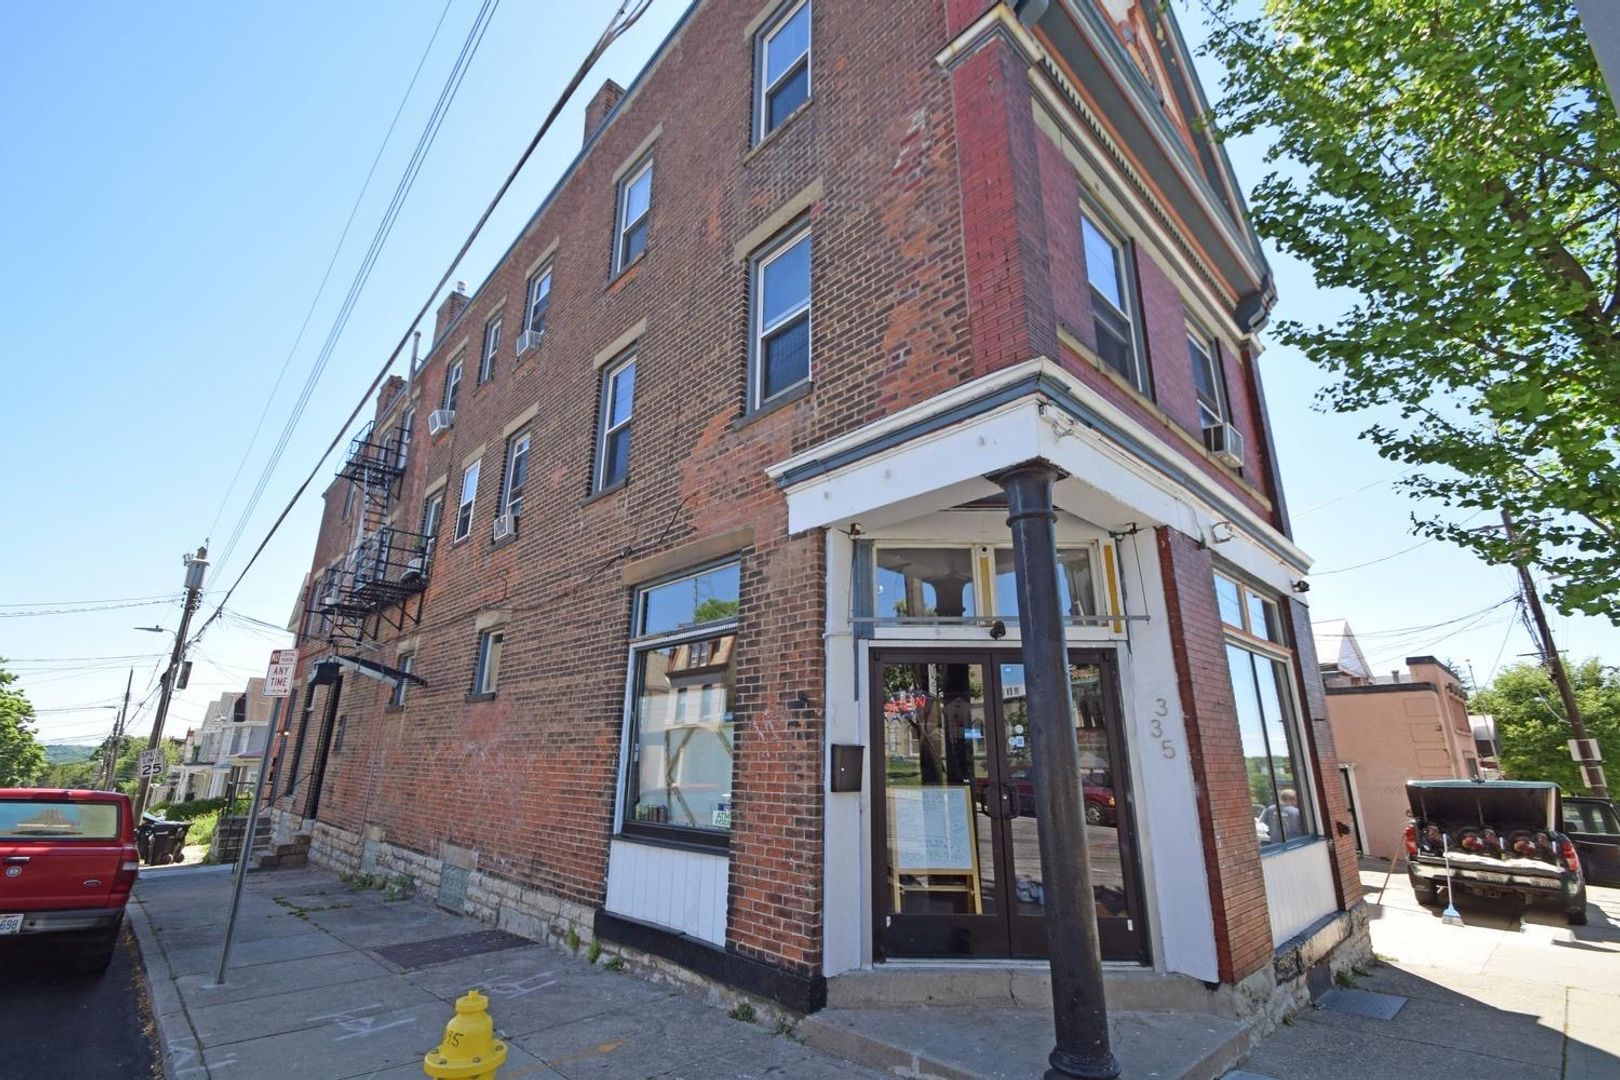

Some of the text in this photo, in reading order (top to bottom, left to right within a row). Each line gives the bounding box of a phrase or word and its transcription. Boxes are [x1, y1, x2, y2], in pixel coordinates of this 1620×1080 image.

[273, 666, 289, 675] ANY
[271, 677, 288, 687] TIME
[1150, 698, 1176, 759] 335
[142, 763, 162, 775] 25
